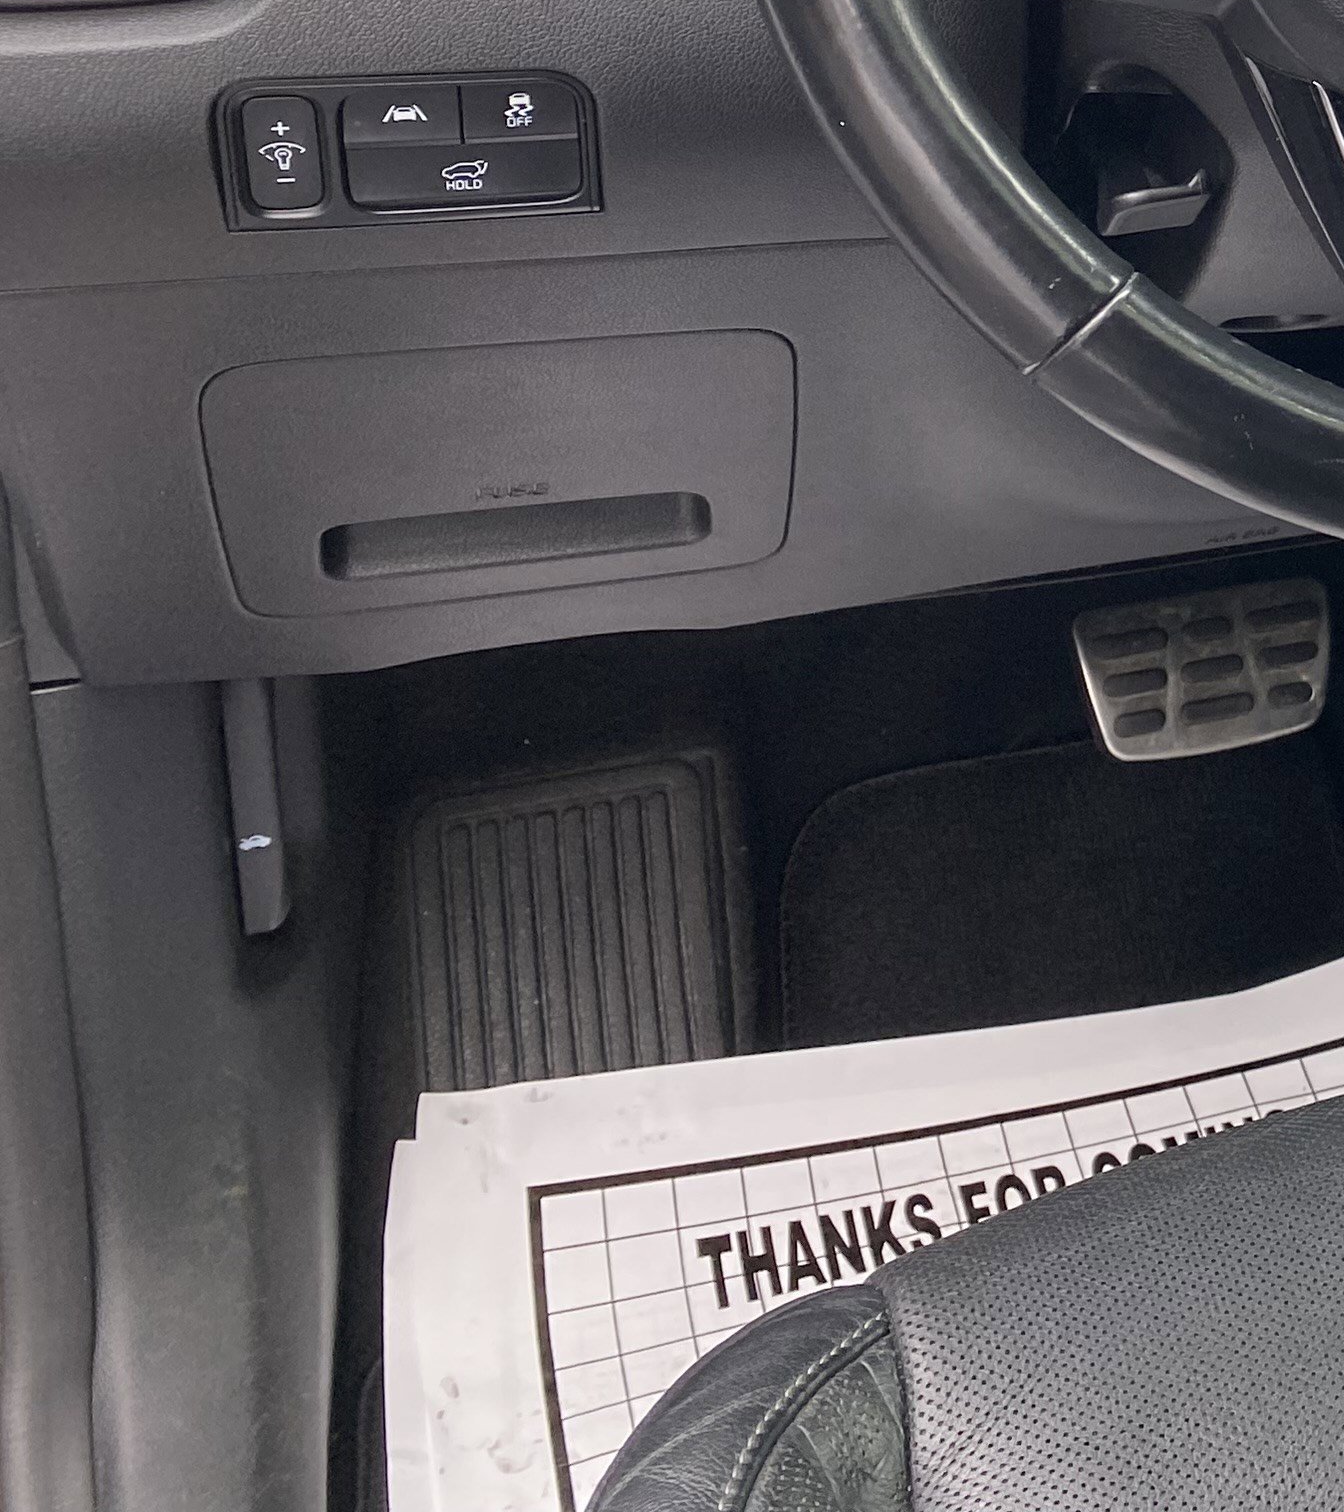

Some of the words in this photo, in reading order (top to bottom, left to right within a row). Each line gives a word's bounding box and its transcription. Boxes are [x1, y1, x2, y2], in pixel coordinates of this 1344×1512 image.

[505, 114, 534, 129] OFF
[444, 176, 484, 192] HOLD
[696, 1191, 943, 1311] THANKS
